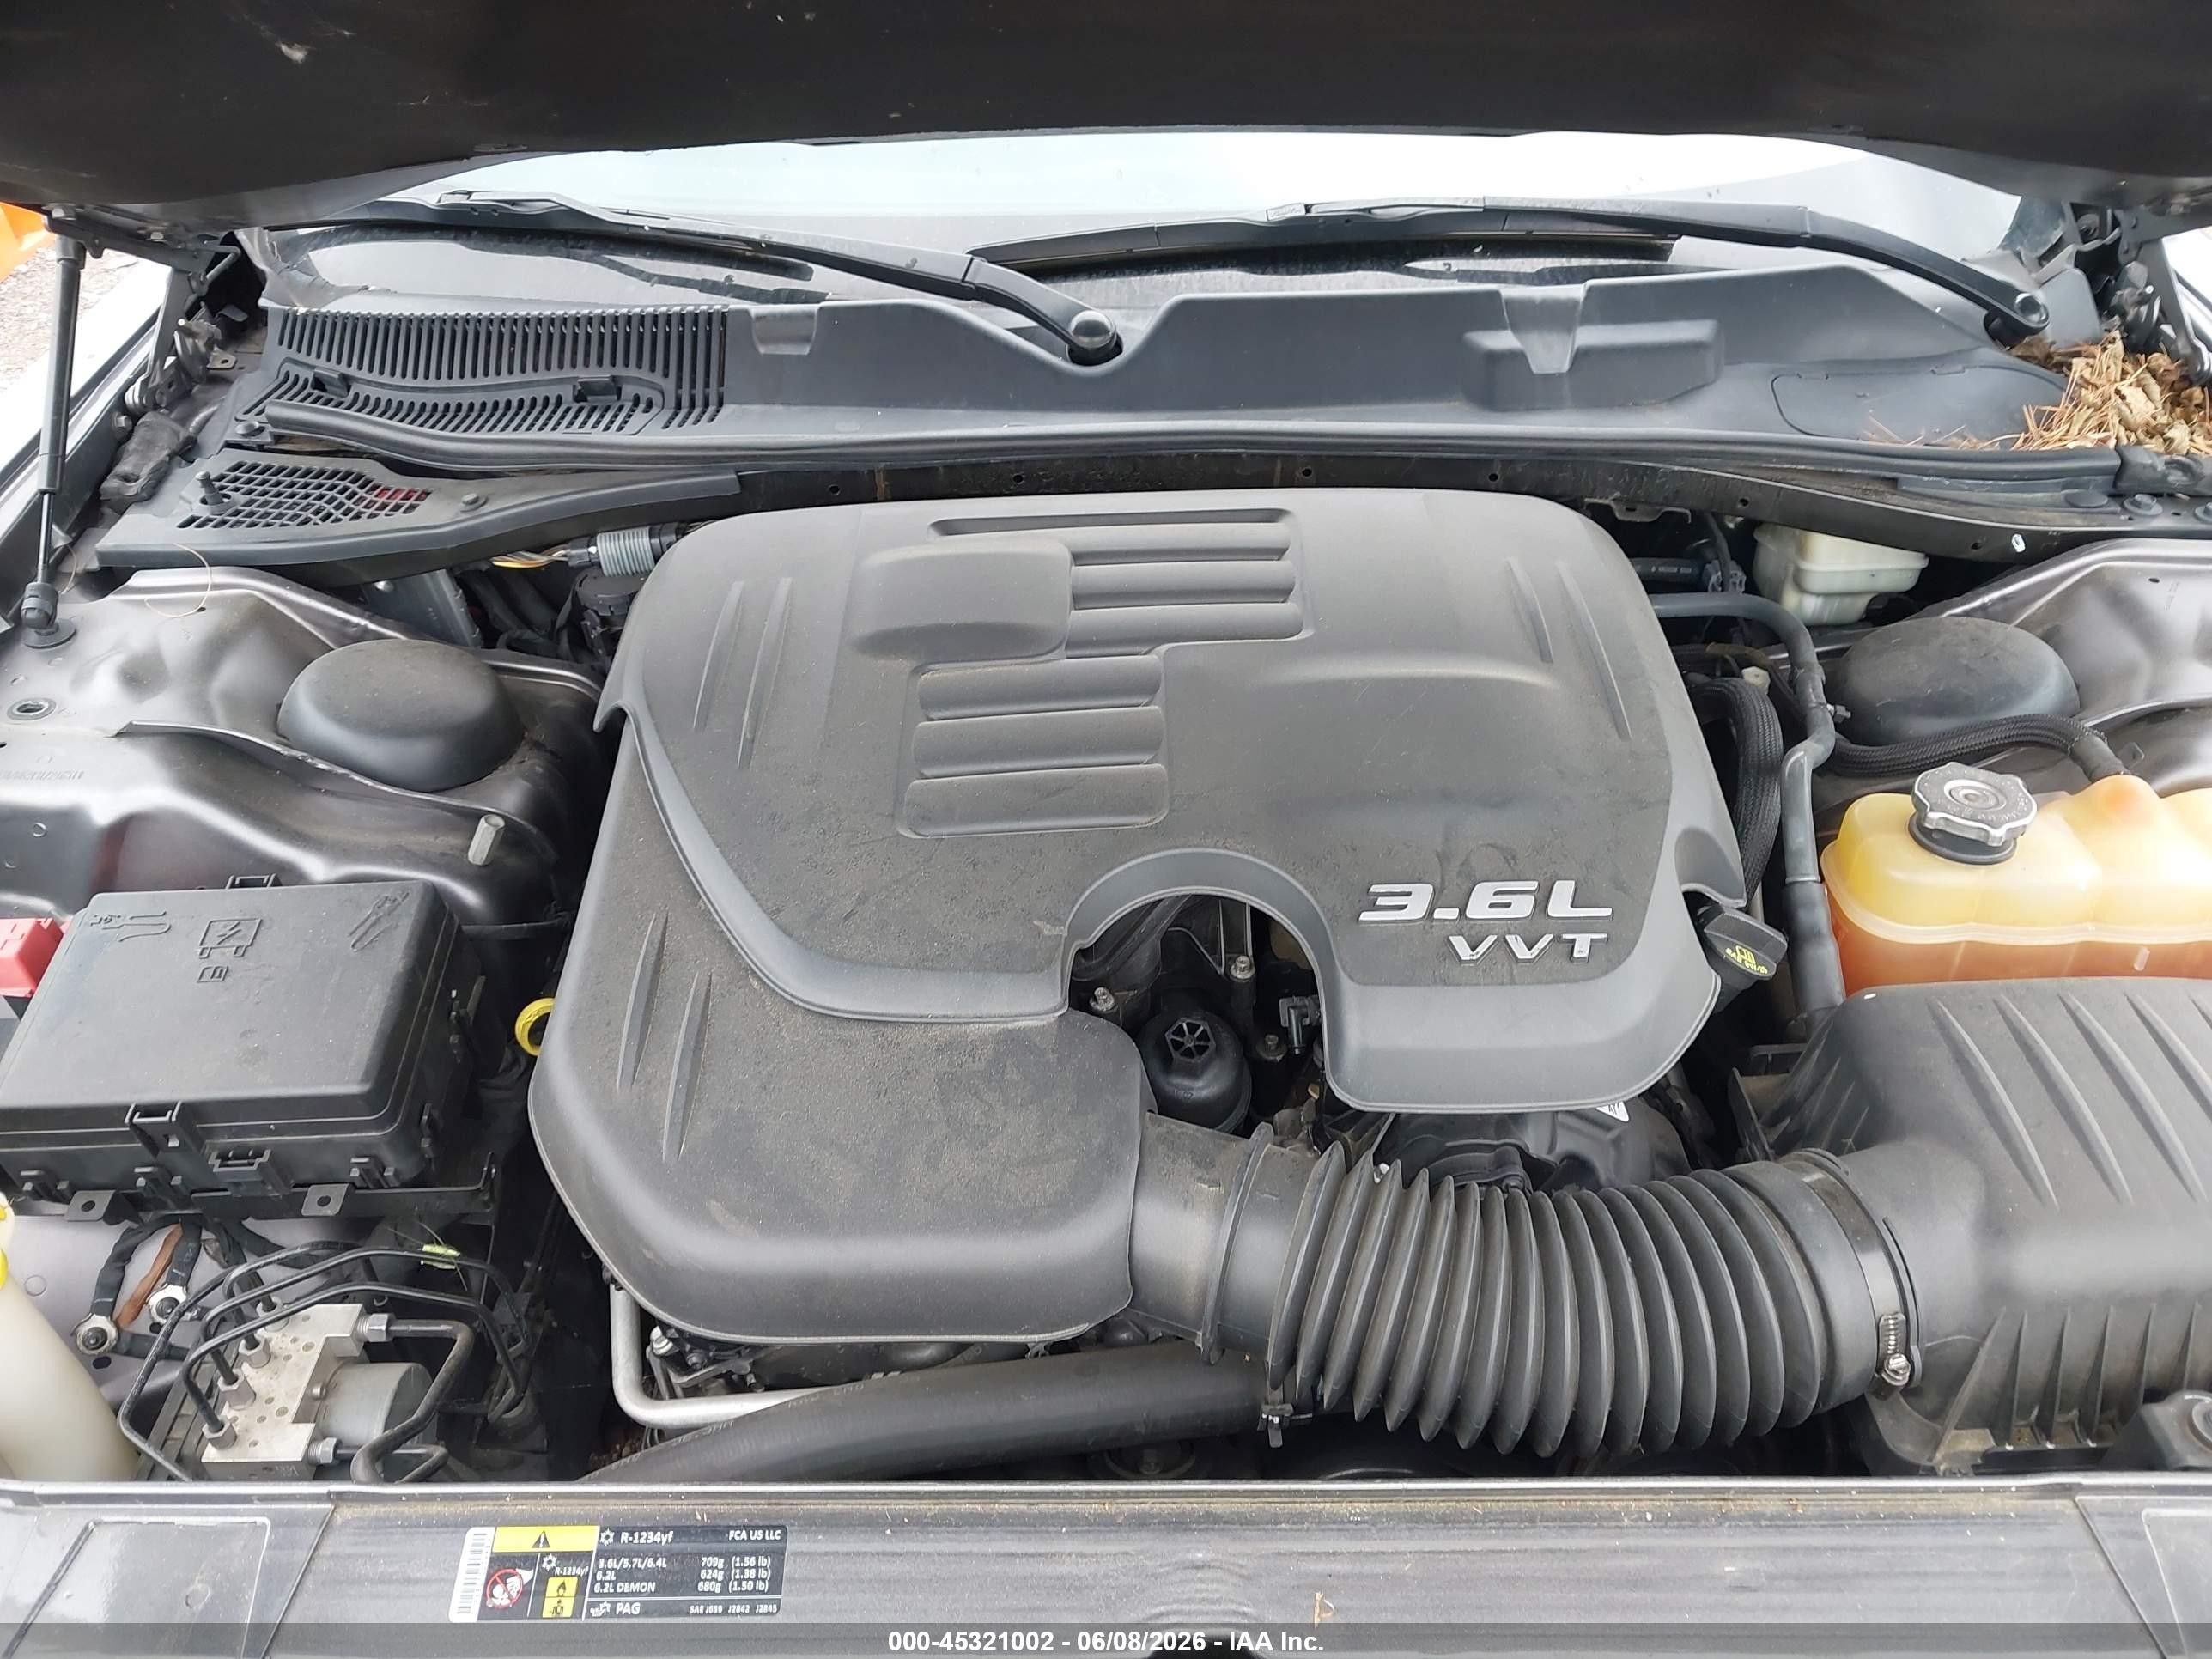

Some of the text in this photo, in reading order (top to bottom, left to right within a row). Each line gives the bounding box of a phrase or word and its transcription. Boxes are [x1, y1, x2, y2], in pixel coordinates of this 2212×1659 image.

[1358, 880, 1613, 921] 3.6L
[1449, 933, 1608, 964] VVT
[620, 1530, 674, 1546] R-1234yf
[728, 1529, 781, 1540] FCA US LLC
[701, 1556, 725, 1569] 709g
[731, 1556, 757, 1568] (1.56
[757, 1555, 771, 1568] lb)
[596, 1567, 771, 1581] 6.2L 624g (1.38 lb)
[593, 1580, 769, 1594] 6.2L DEMON 680g (1.50 lb)
[616, 1602, 641, 1615] PAG
[690, 1604, 705, 1614] SAE
